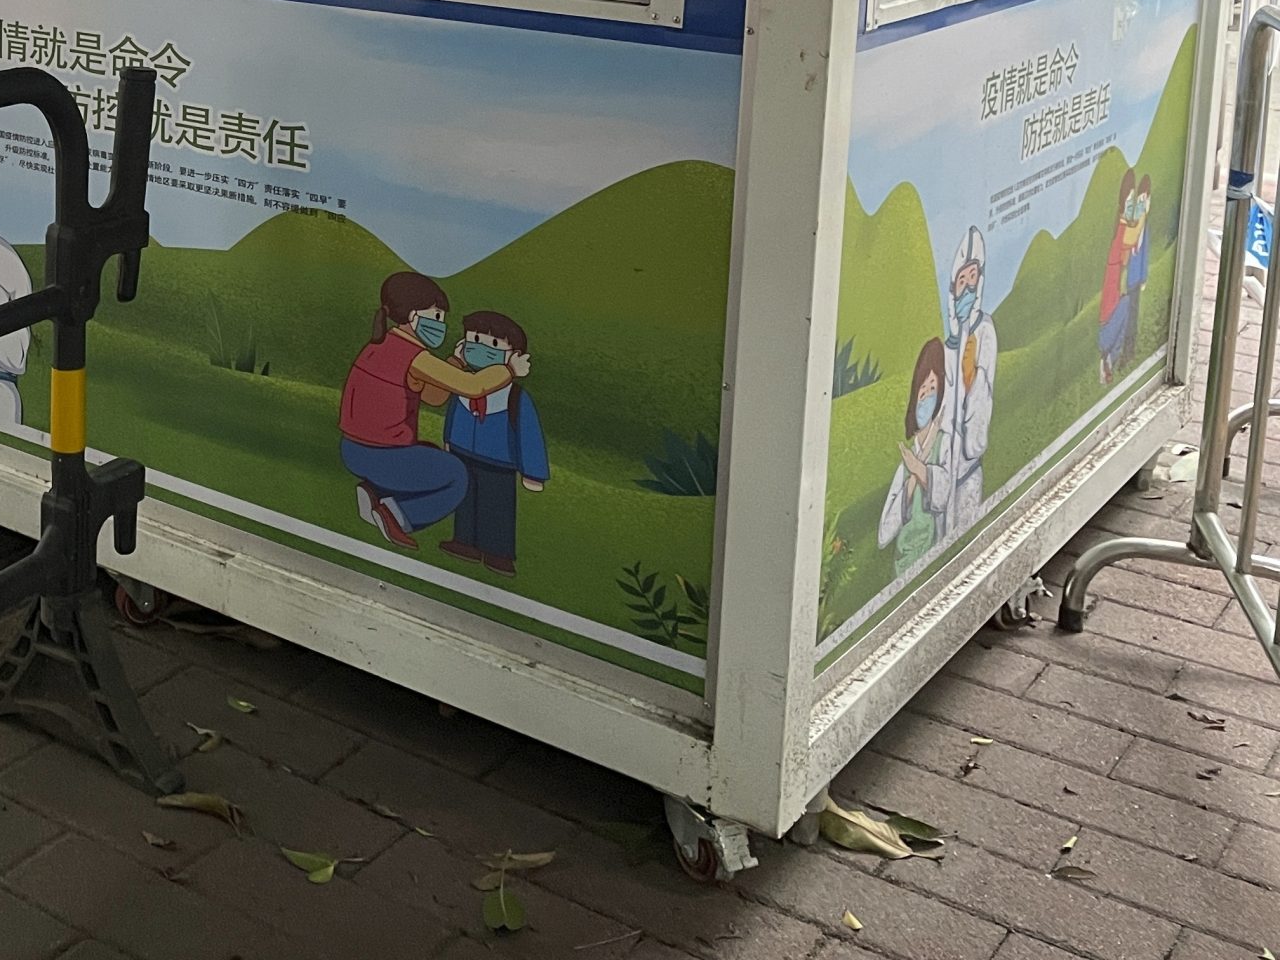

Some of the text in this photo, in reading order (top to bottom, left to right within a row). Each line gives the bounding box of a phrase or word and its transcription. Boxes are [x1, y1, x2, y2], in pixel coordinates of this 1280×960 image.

[981, 42, 1080, 121] 疫情就是命令
[1020, 81, 1111, 161] 防控就是责任
